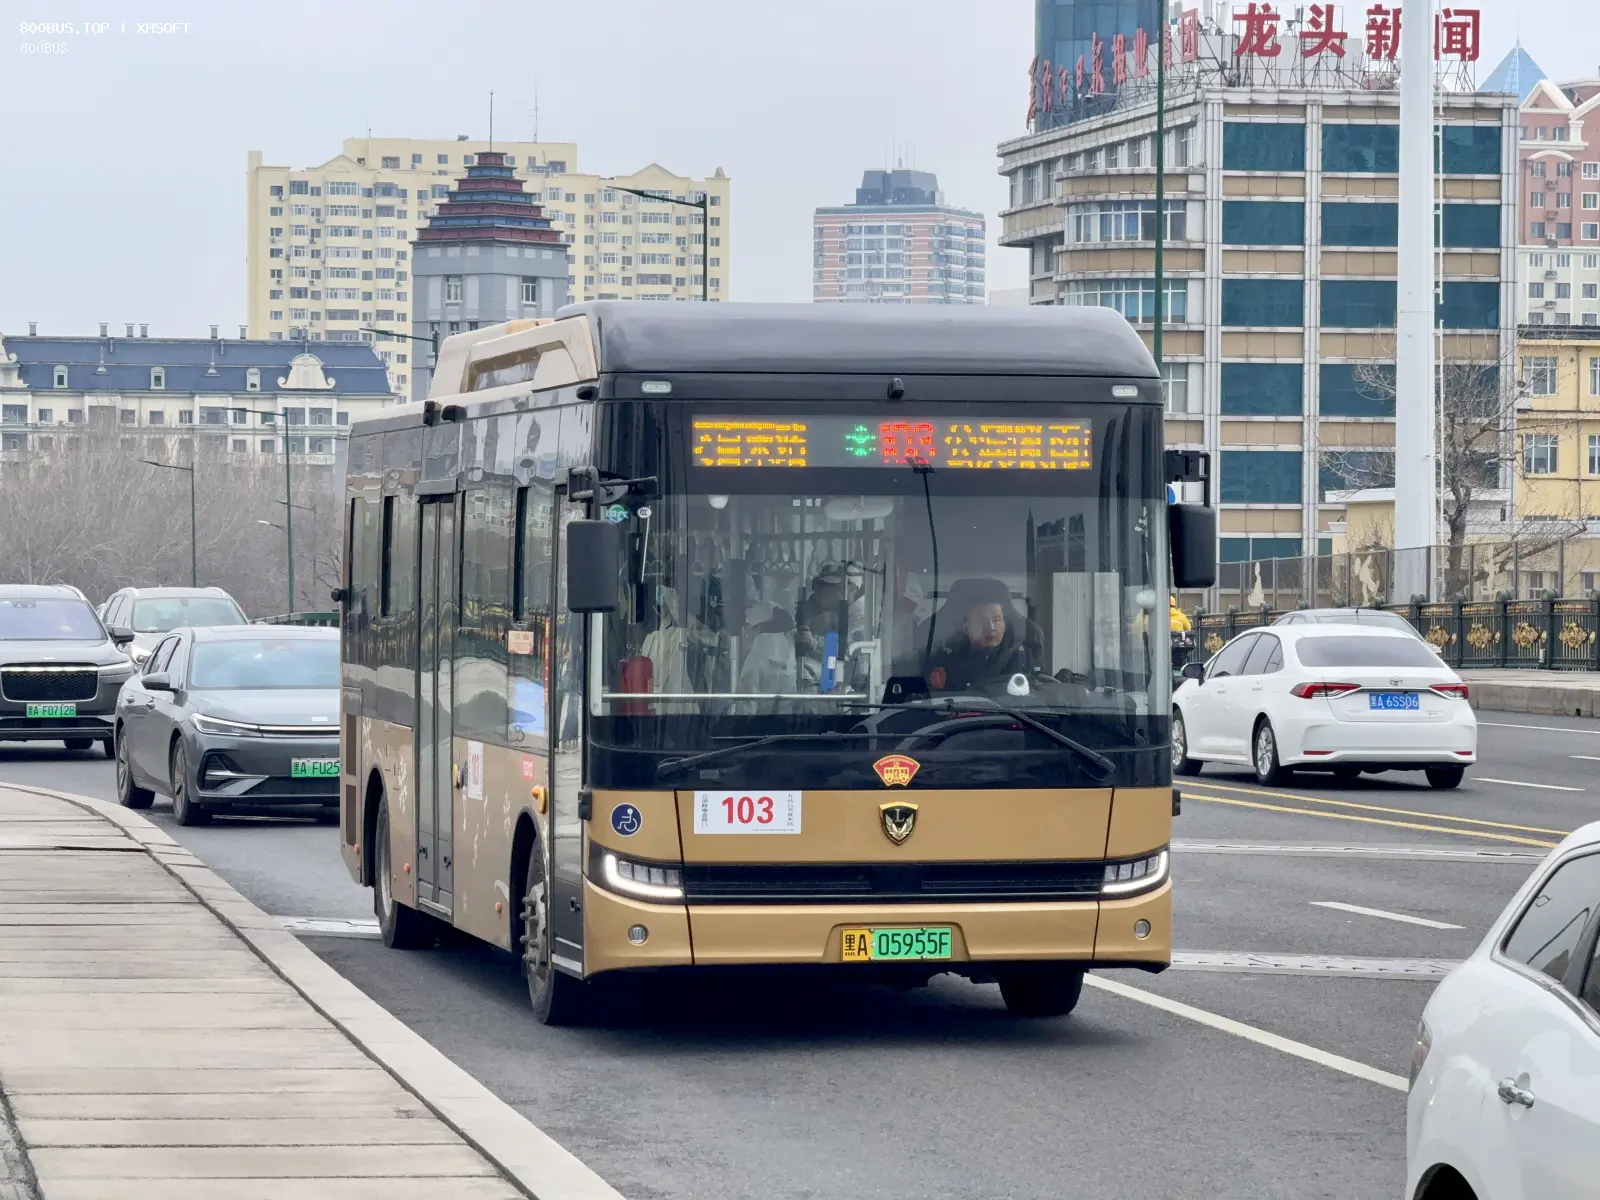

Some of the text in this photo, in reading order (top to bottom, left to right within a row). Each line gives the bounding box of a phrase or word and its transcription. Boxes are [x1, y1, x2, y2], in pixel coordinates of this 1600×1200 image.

[1233, 3, 1480, 61] 龙头新闻
[721, 796, 775, 824] 103
